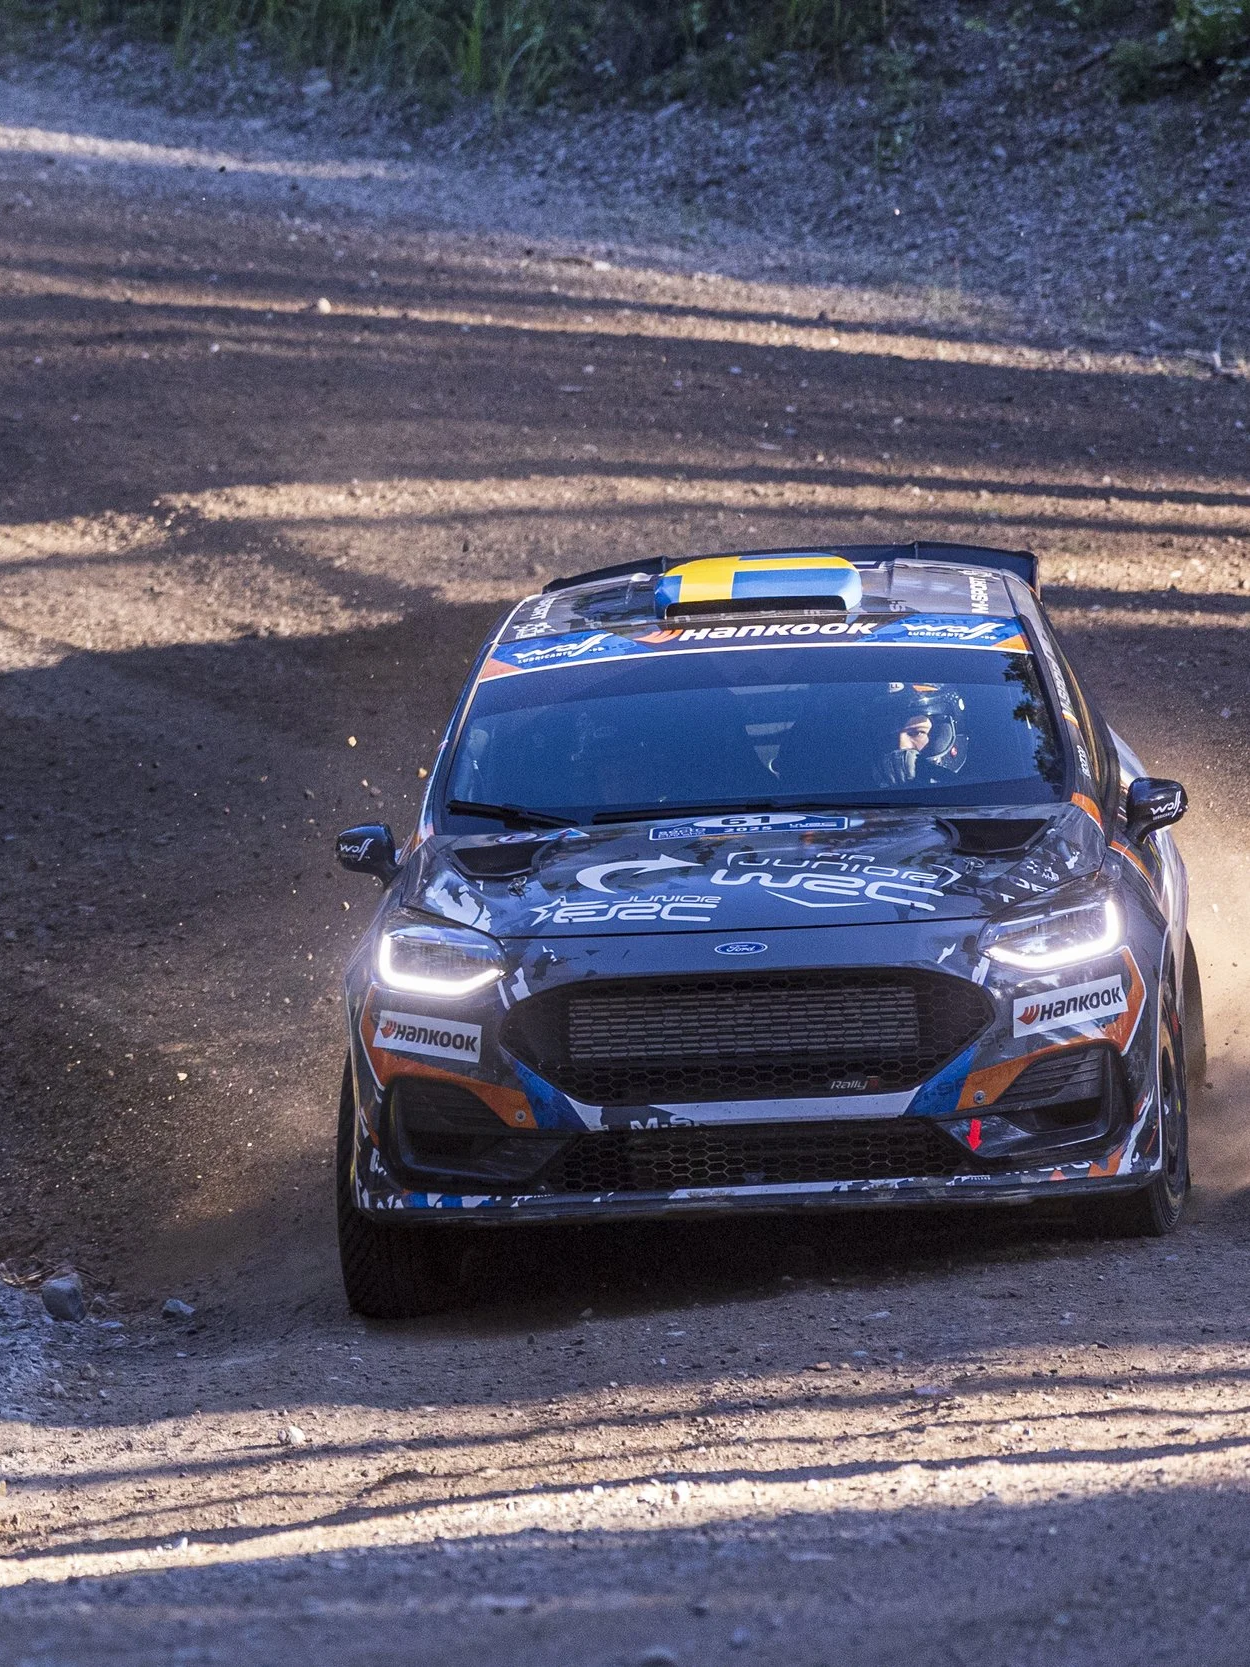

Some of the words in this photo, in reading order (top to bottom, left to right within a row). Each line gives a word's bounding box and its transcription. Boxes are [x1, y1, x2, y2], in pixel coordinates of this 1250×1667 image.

[721, 815, 771, 826] 61
[724, 825, 772, 833] 2025
[816, 851, 876, 863] FIA
[738, 858, 939, 884] JUNIOR
[710, 868, 945, 912] WRC
[612, 895, 722, 904] JUNIOR
[552, 902, 718, 924] ERC
[726, 944, 756, 953] Ford
[830, 1080, 868, 1091] Rally
